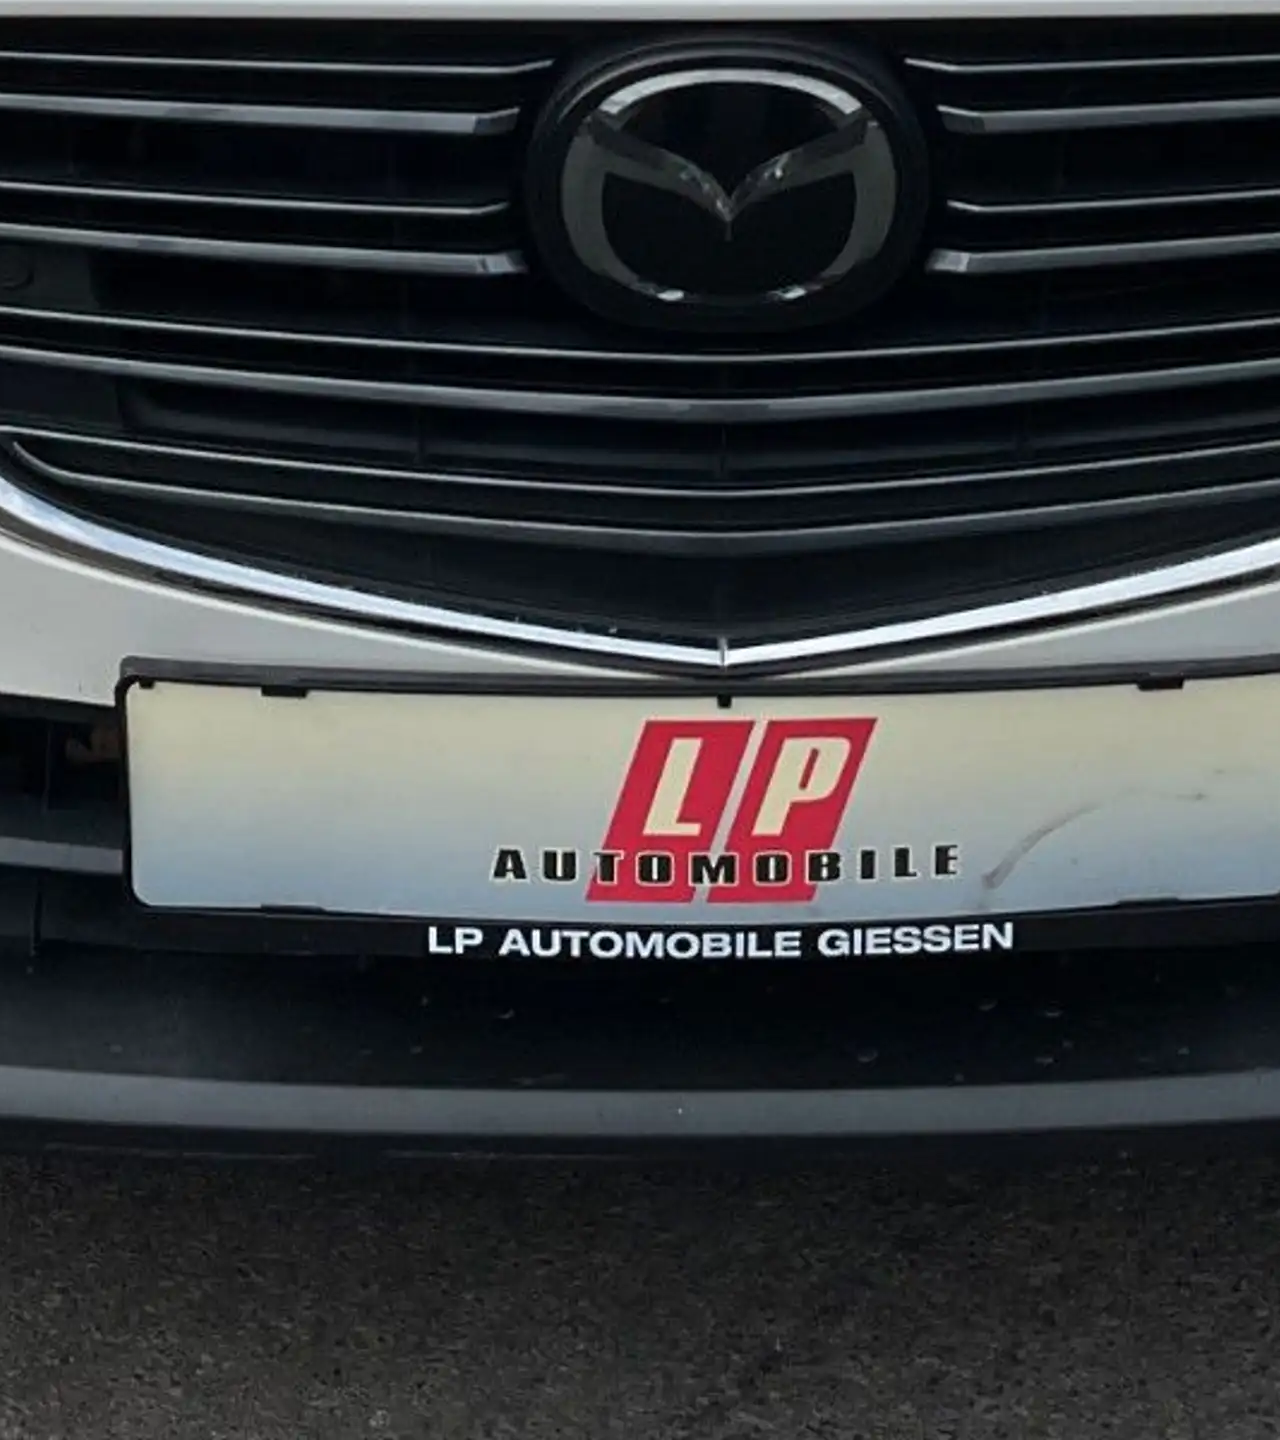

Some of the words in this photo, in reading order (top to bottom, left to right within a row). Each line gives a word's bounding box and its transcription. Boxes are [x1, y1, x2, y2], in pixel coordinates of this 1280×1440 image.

[641, 736, 852, 837] LP
[490, 844, 960, 885] AUTOMOBILE
[427, 925, 484, 955] LP
[497, 927, 804, 959] AUTOMOBILE
[816, 921, 1015, 957] GIESSEN
